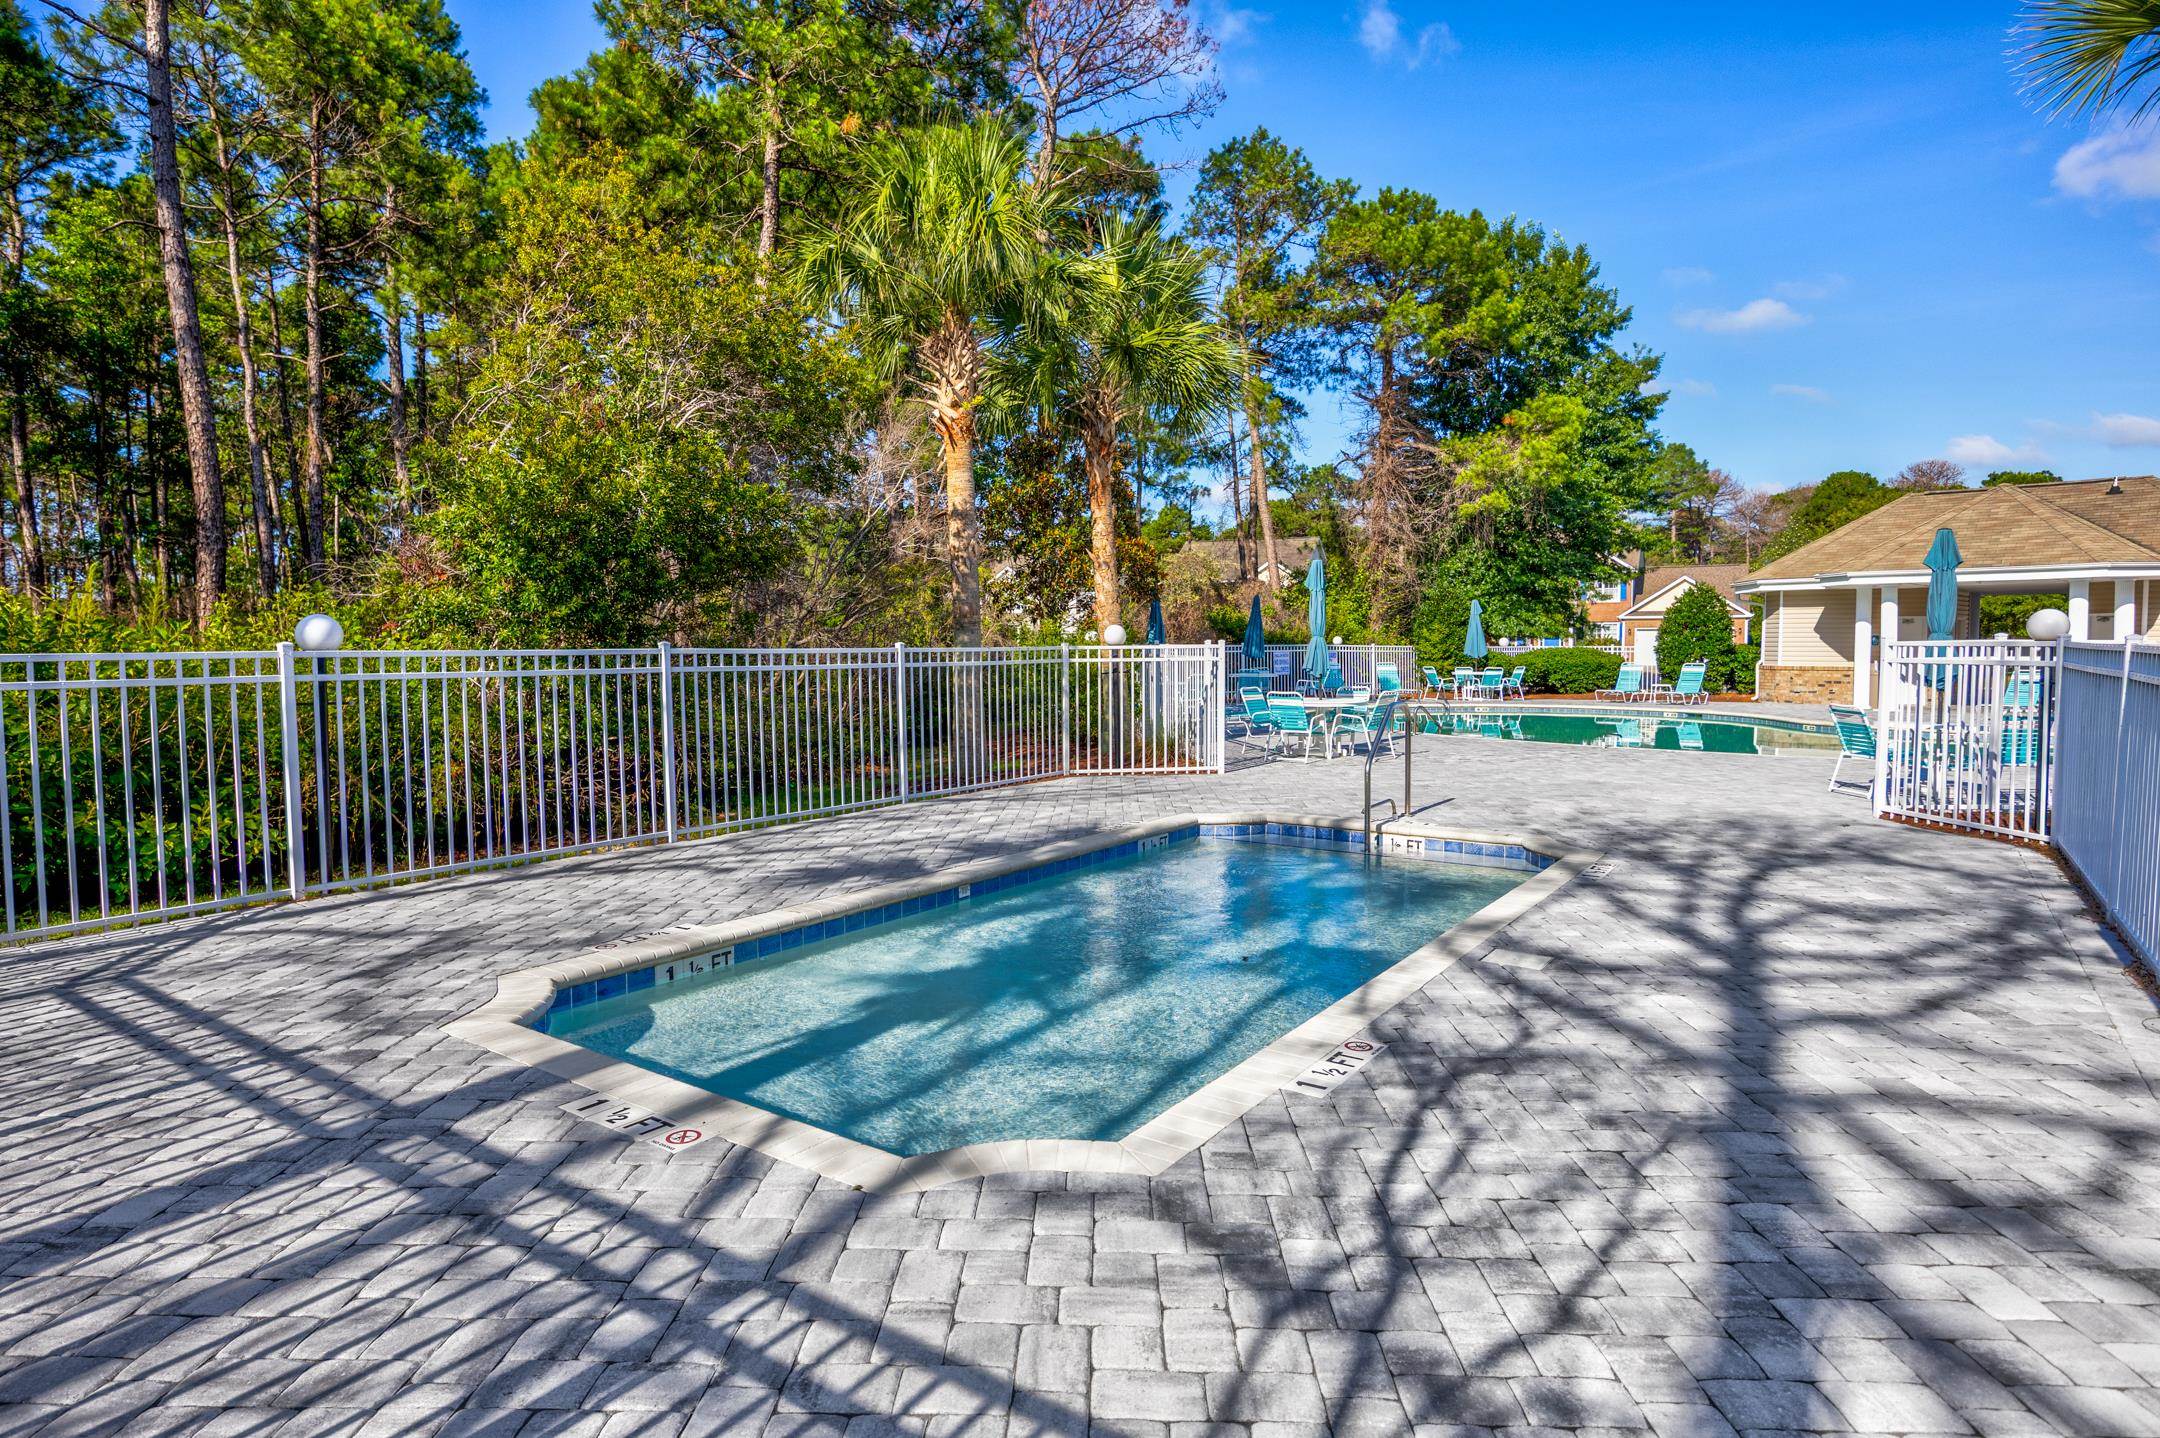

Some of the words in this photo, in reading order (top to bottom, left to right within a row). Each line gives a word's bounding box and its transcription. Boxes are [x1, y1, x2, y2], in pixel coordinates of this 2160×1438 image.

[1406, 839, 1423, 850] FT
[665, 965, 674, 981] 1
[711, 950, 732, 969] FT
[1296, 1080, 1328, 1091] 1
[1326, 1051, 1364, 1068] FT
[576, 1099, 610, 1112] 1
[623, 1116, 676, 1136] FT
